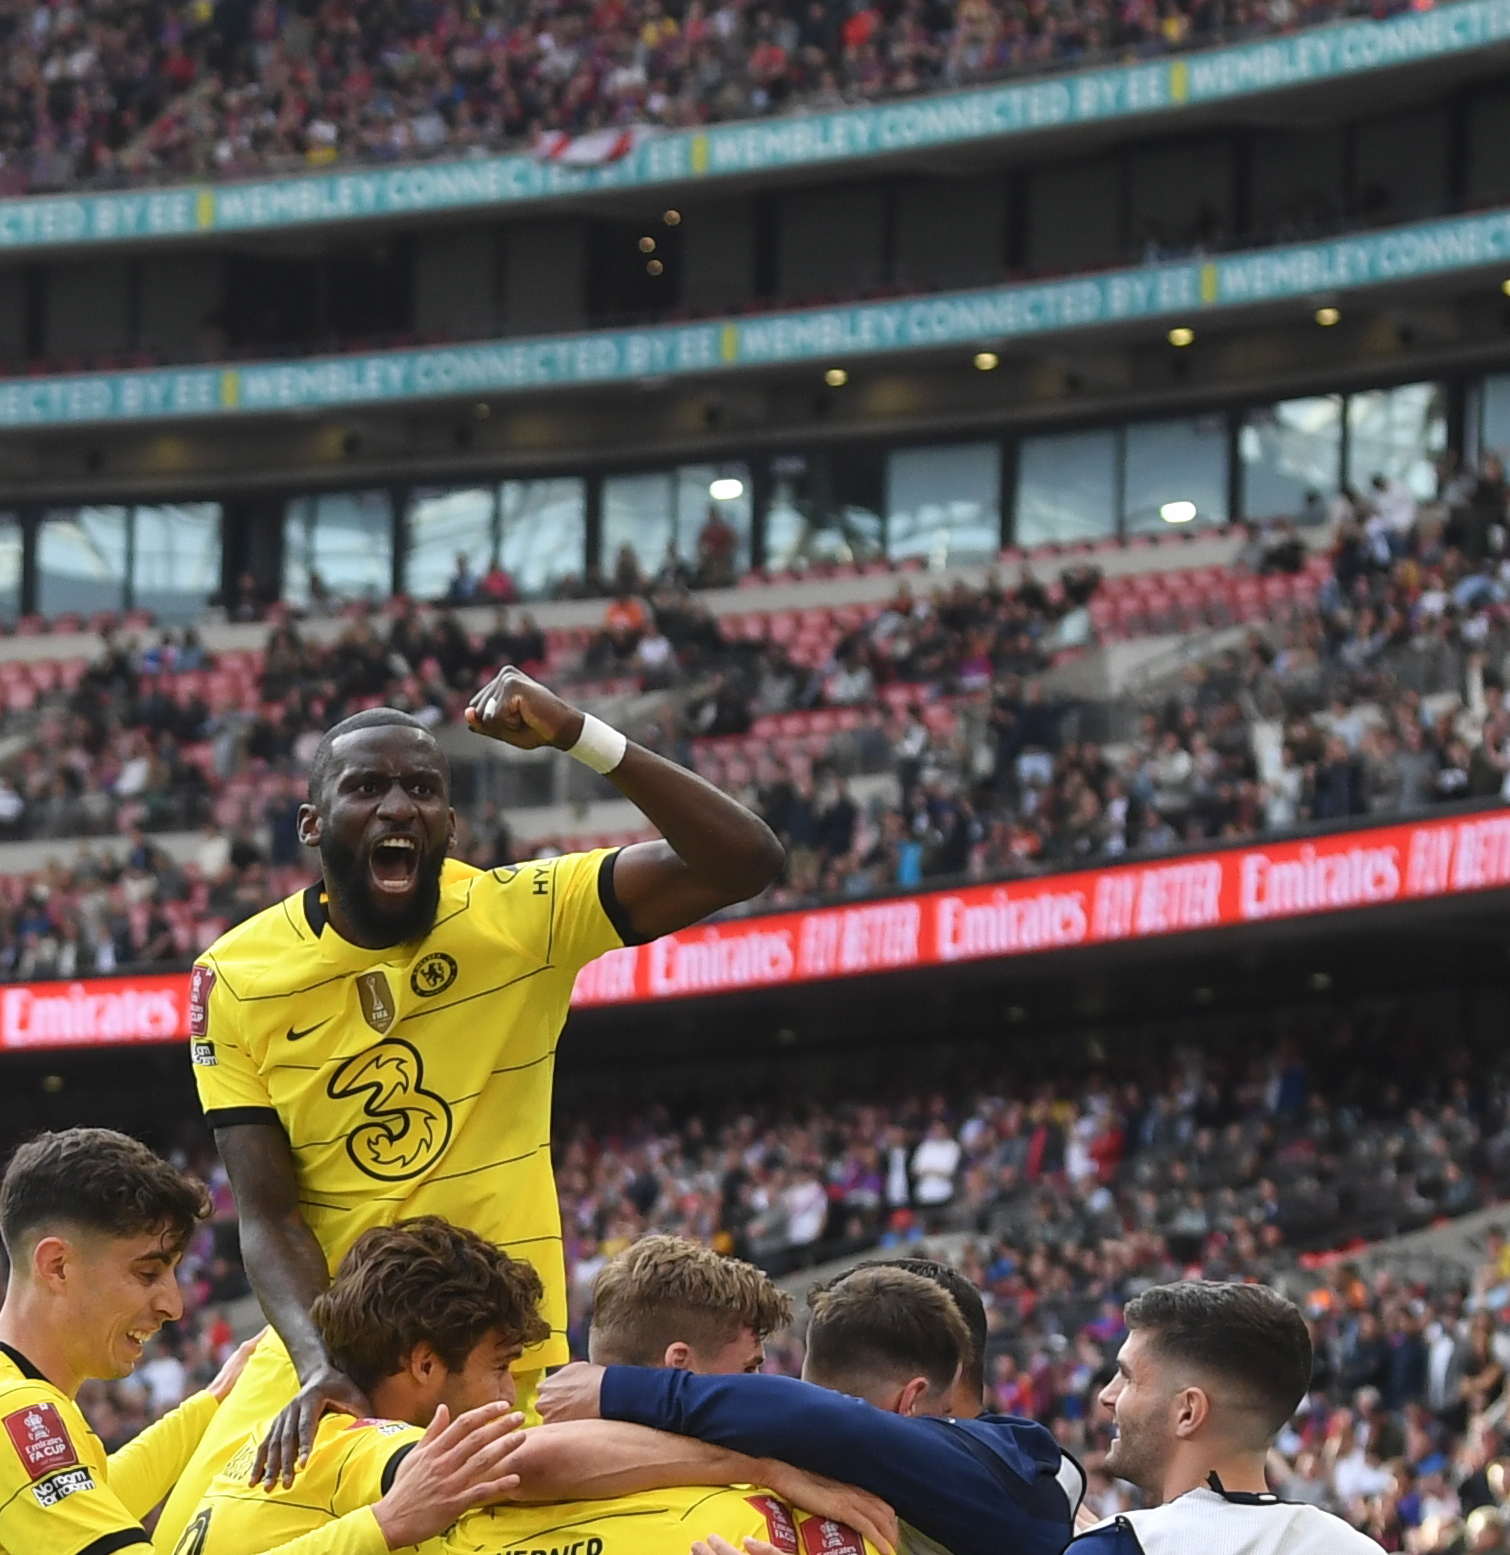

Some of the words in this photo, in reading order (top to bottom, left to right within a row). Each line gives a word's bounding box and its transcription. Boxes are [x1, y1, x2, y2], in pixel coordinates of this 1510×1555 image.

[1188, 33, 1333, 95] WEMBLEY
[713, 112, 877, 170] WEMBLEY
[883, 81, 1069, 147] CONNECTED
[1078, 71, 1123, 115] BY
[94, 195, 140, 236] BY
[219, 173, 378, 224] WEMBLEY
[1223, 239, 1375, 298] WEMBLEY
[742, 303, 902, 358] WEMBLEY
[909, 279, 1098, 338] CONNECTED
[1109, 272, 1152, 313] BY
[122, 374, 171, 414] BY
[246, 358, 411, 405] WEMBLEY
[417, 337, 618, 394] CONNECTED
[627, 330, 673, 372] BY
[1241, 844, 1400, 921] Emirates
[1407, 828, 1453, 896] FLY
[936, 890, 1087, 962] Emirates
[1092, 874, 1135, 939] FLY
[1133, 860, 1222, 936] BETTER
[649, 929, 794, 995] Emirates
[796, 915, 840, 976] FLY
[840, 901, 920, 974] BETTER
[1, 983, 179, 1047] Emirates
[371, 1009, 389, 1021] FIFA
[24, 1436, 64, 1455] Emirates
[29, 1451, 45, 1464] FA
[44, 1443, 67, 1457] CUP
[31, 1482, 54, 1500] No
[51, 1470, 87, 1489] room
